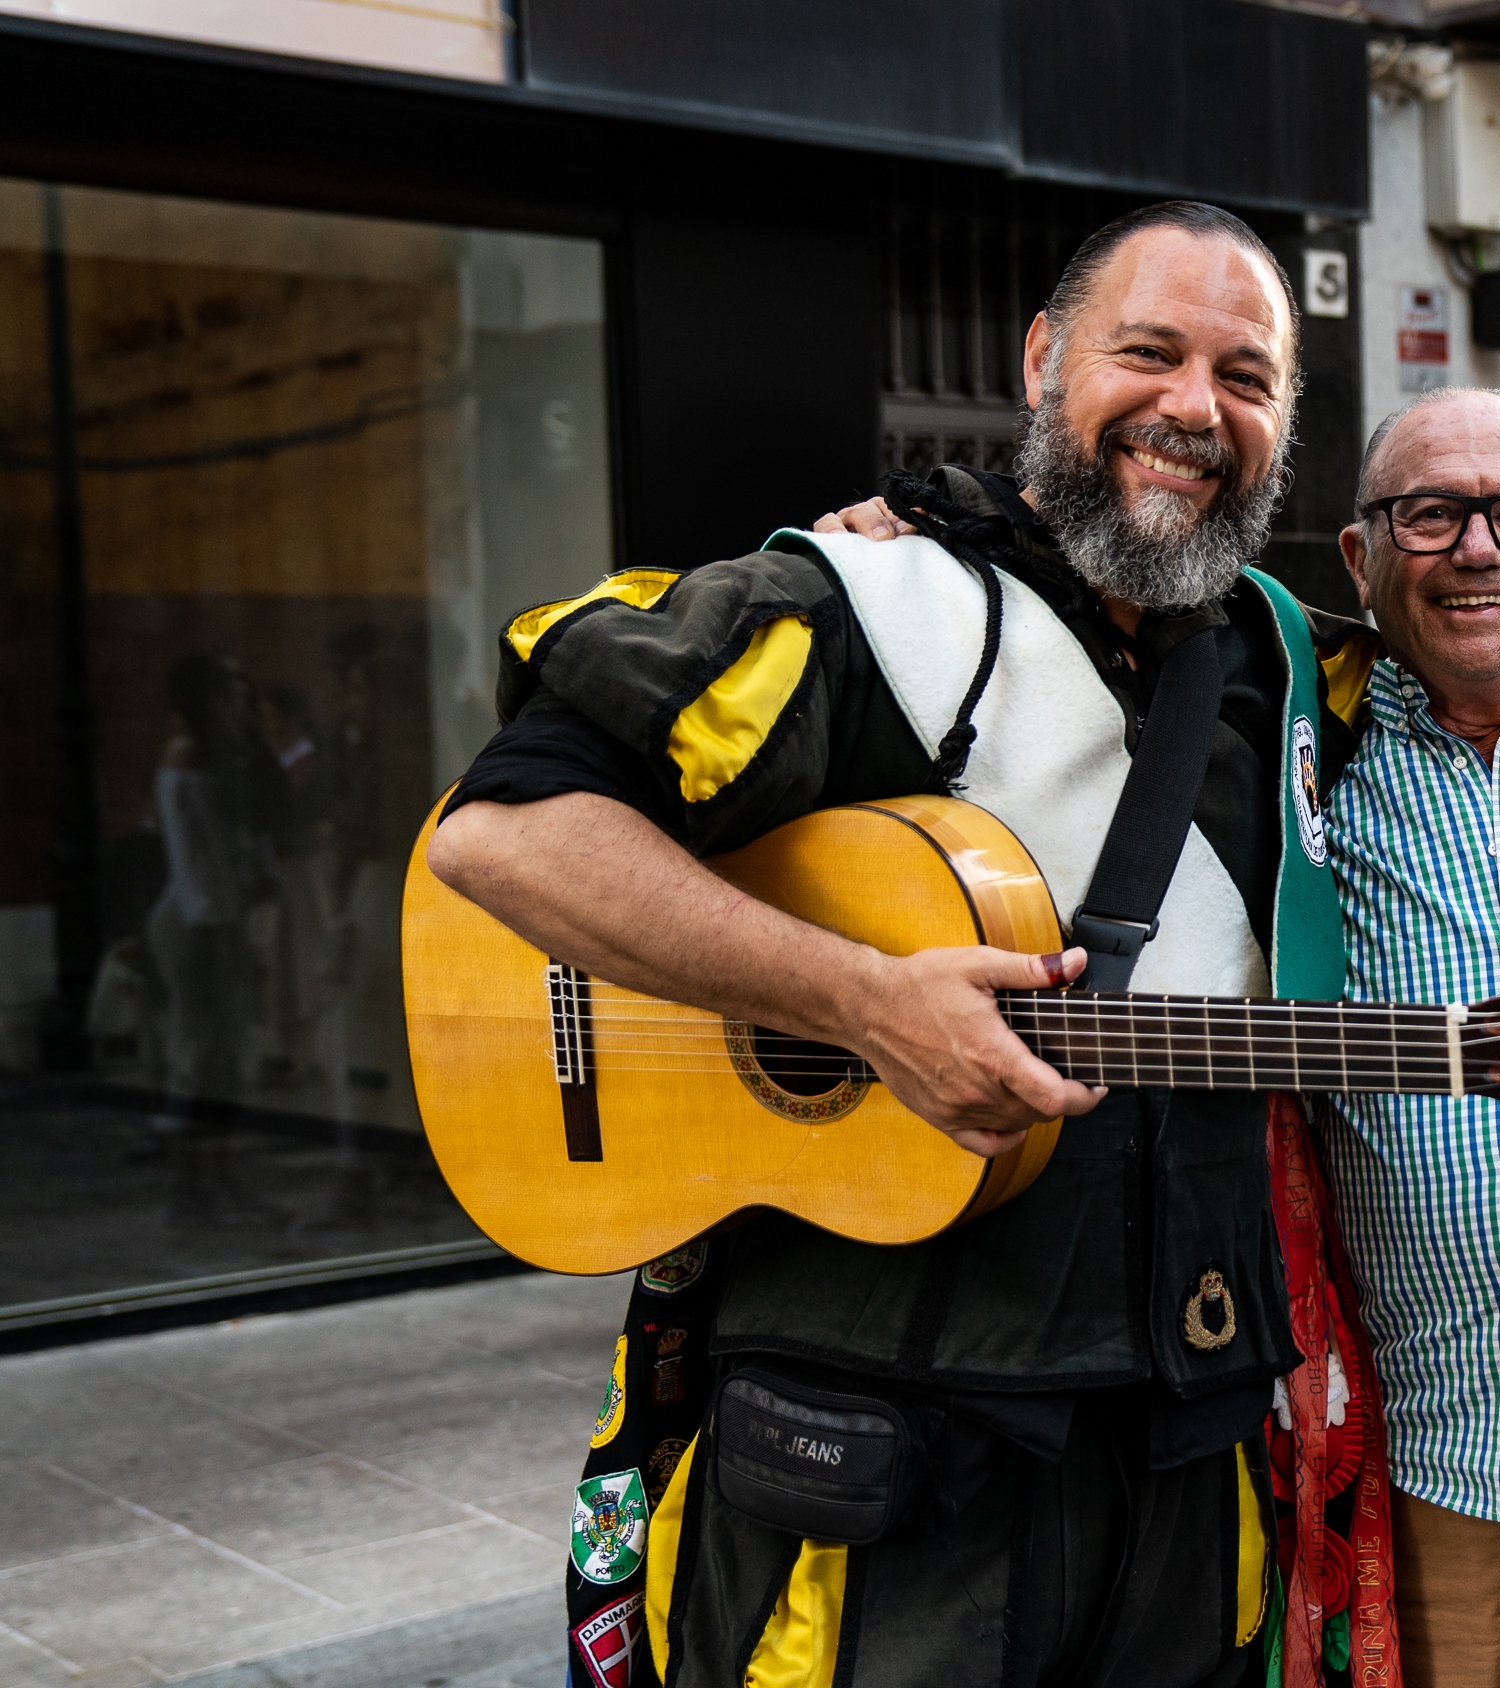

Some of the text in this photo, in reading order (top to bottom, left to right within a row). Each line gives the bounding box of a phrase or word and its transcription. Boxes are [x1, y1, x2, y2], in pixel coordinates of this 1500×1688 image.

[785, 1435, 845, 1466] JEANS
[595, 1564, 626, 1576] PORTO
[1357, 1535, 1381, 1587] ME
[581, 1595, 644, 1641] DANMARK
